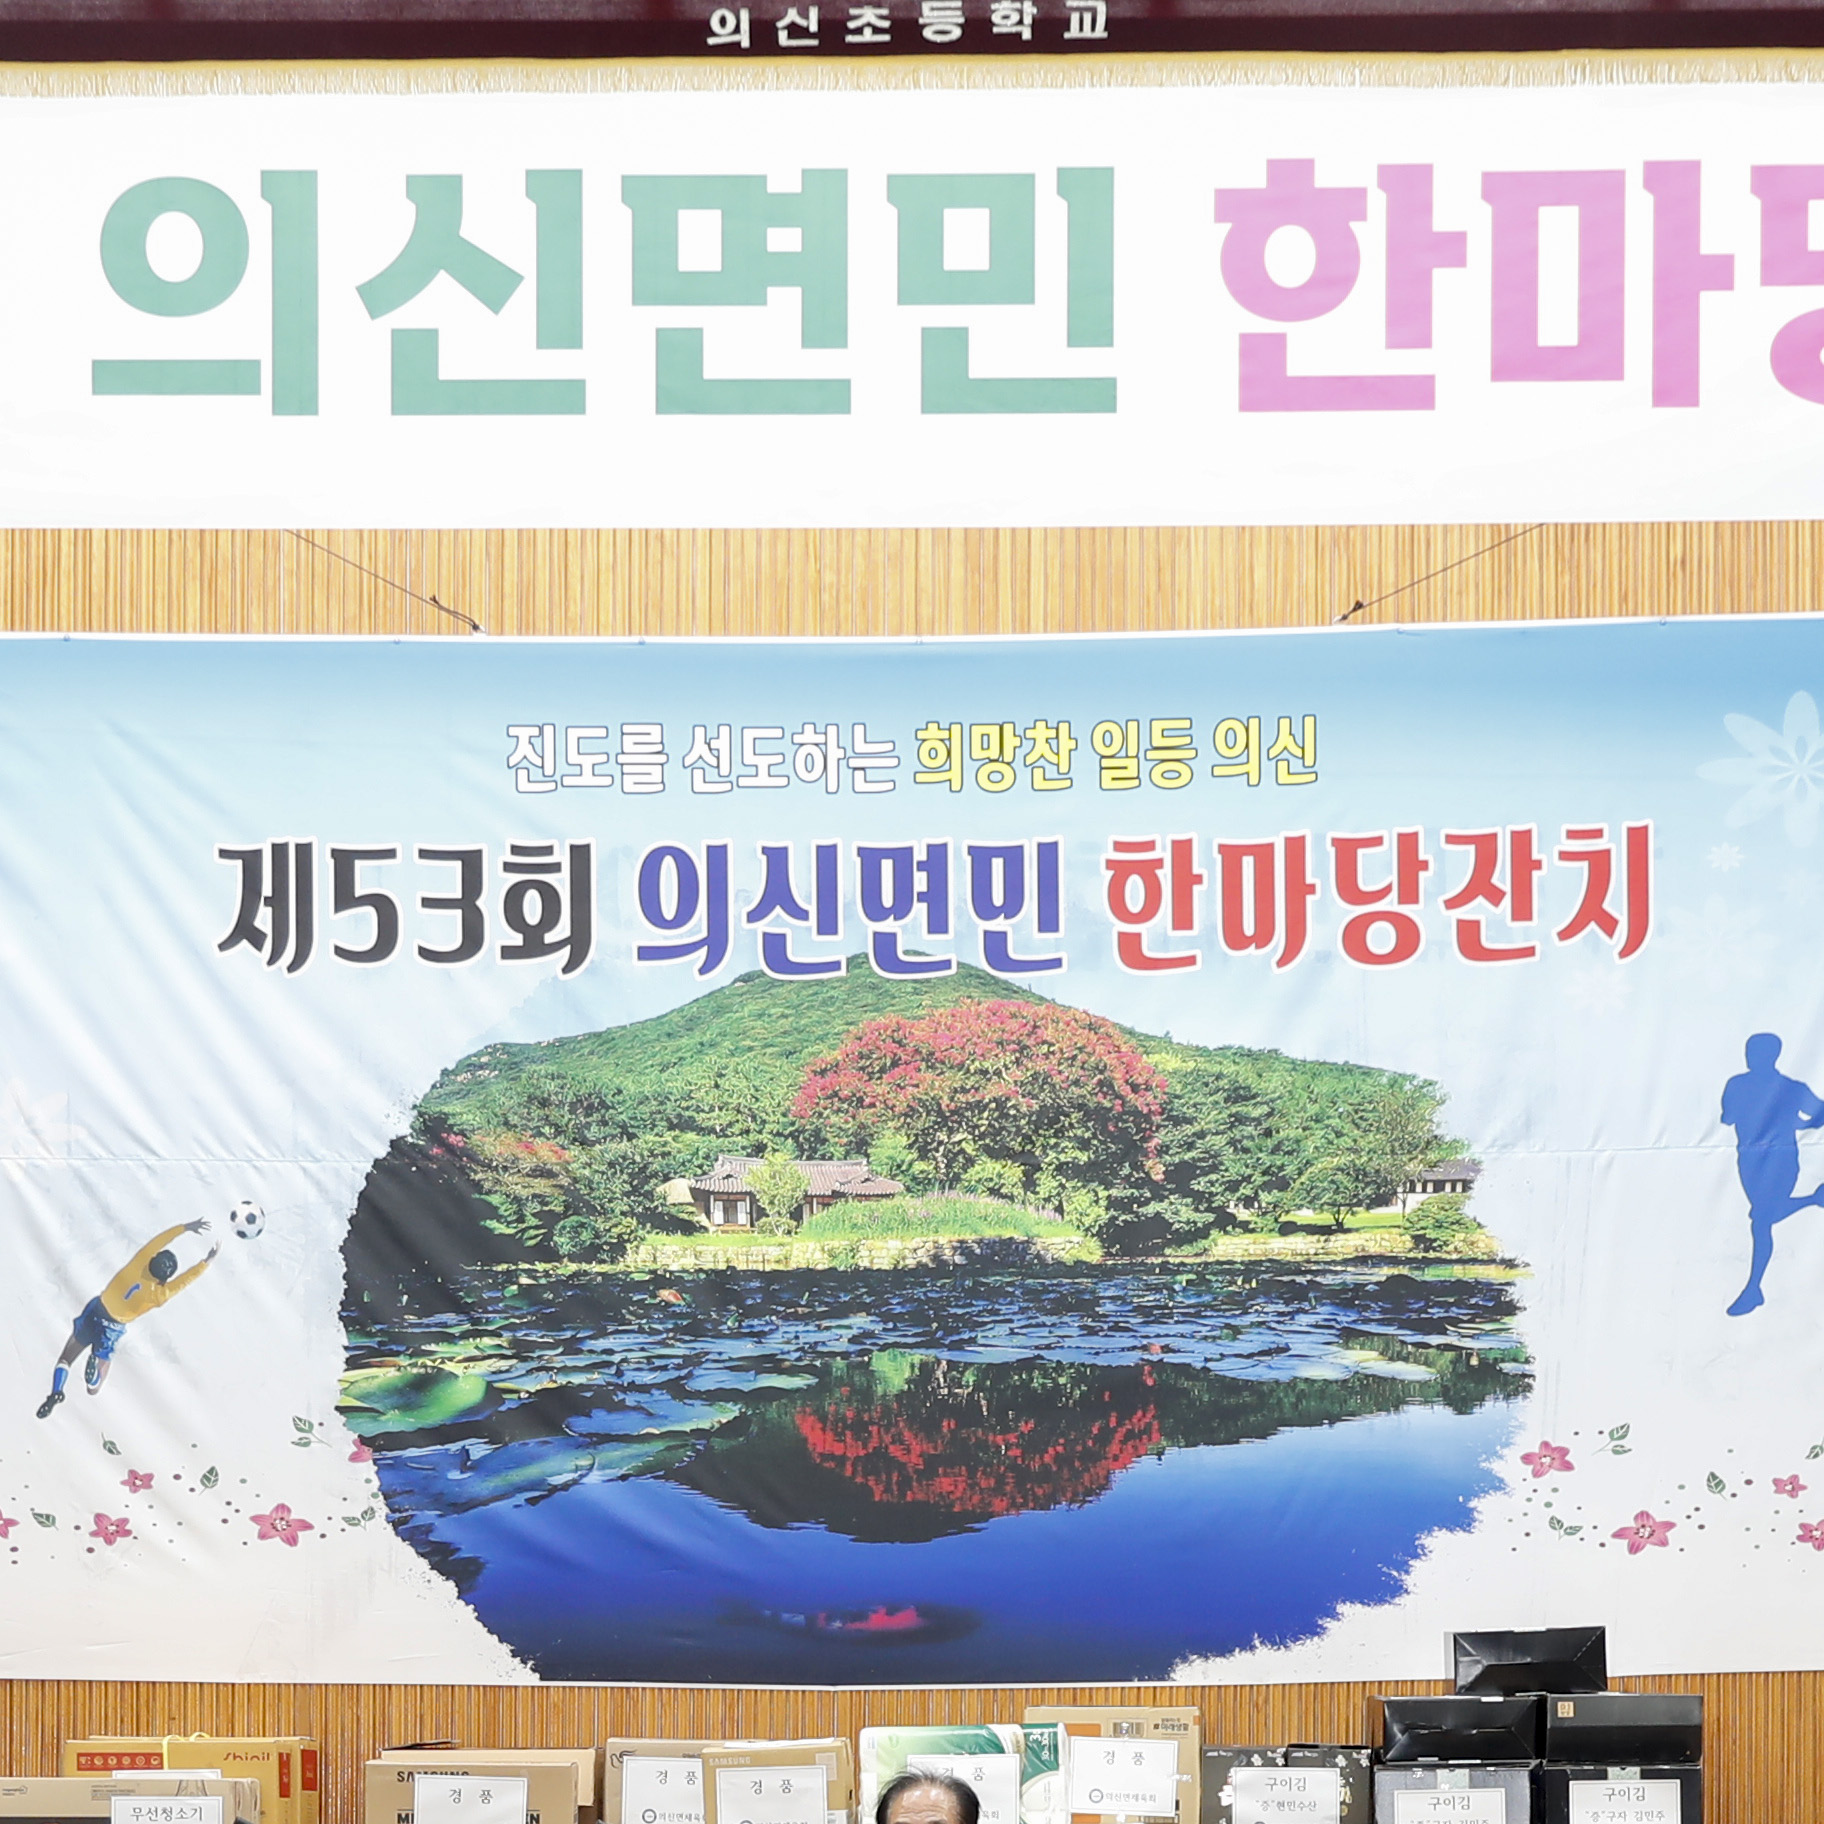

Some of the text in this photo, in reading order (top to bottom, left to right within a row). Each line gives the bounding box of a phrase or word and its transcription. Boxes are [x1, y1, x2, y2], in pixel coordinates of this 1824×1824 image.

[706, 0, 1109, 49] 의신초등학교
[91, 165, 1118, 417] 의신면민
[503, 713, 1321, 796] 진도를 선도하는 희망찬 일등 의신
[214, 818, 1656, 980] 제53회 의신면민 한마당잔치
[1264, 1777, 1307, 1792] 구이김
[1427, 1795, 1471, 1811] 구이김
[1602, 1786, 1647, 1803] 구이김
[129, 1806, 204, 1823] 무선청소기
[1633, 1809, 1666, 1823] 김민주
